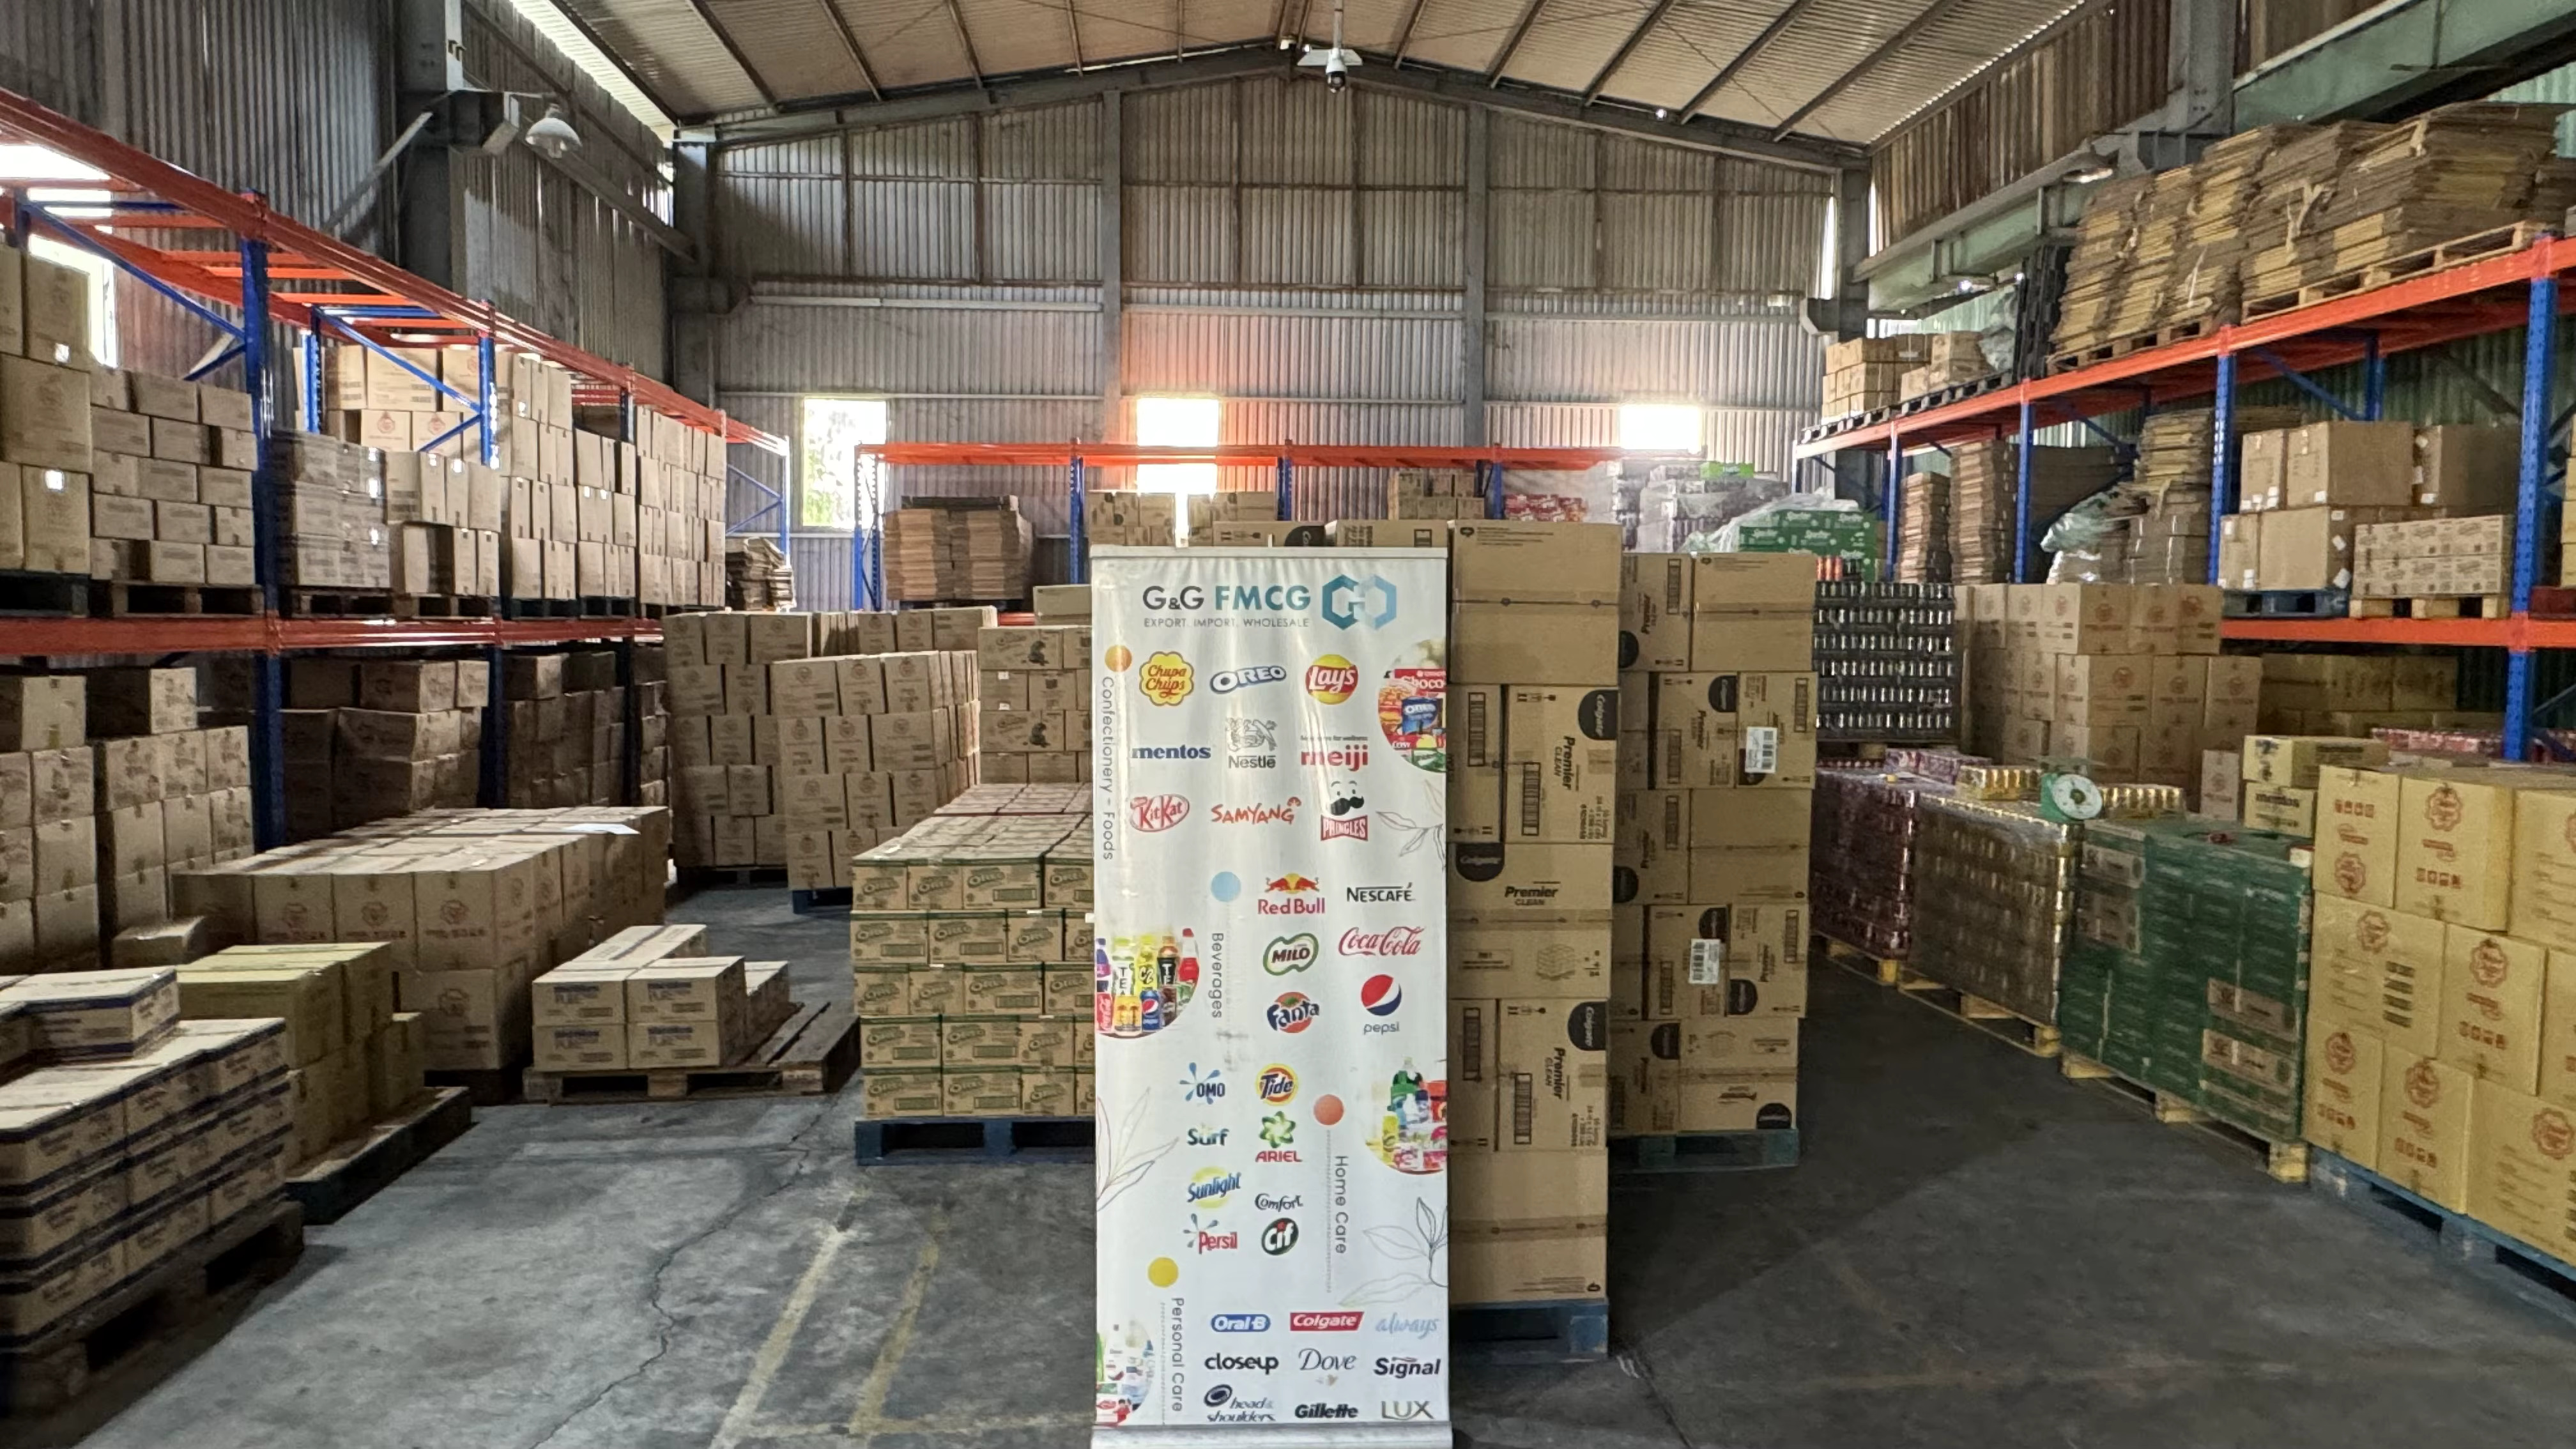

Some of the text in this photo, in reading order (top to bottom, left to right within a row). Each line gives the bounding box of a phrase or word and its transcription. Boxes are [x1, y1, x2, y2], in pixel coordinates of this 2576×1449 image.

[1142, 585, 1310, 611] G&G FMCG
[1243, 617, 1309, 627] WHOLESALE
[1147, 664, 1187, 678] Chupa
[1211, 666, 1286, 693] OREO
[1146, 676, 1185, 698] Chups
[1100, 676, 1116, 793] Confectionery
[1131, 744, 1211, 759] mentos
[1301, 744, 1368, 772] meiji
[1562, 735, 1576, 791] Premier
[1139, 795, 1184, 829] KitKat
[1210, 802, 1296, 825] SAMYANG
[1103, 811, 1116, 860] Foods
[1322, 816, 1367, 840] PRINGLES
[1346, 882, 1413, 902] NESCAFÉ
[1504, 885, 1559, 898] Premier
[1257, 897, 1325, 914] Red Bull
[1338, 926, 1426, 956] Coca-Cola
[1271, 947, 1310, 963] MILO
[1208, 933, 1224, 1018] Beverages
[1266, 1000, 1320, 1031] Fanta
[1363, 1022, 1400, 1036] pepsi
[1553, 1046, 1566, 1100] Premier
[1196, 1082, 1225, 1098] OMO
[1260, 1073, 1294, 1100] Tide
[1187, 1127, 1230, 1146] Surf
[1255, 1151, 1303, 1163] ARIEL
[1186, 1172, 1242, 1203] Sunlight
[1254, 1192, 1304, 1213] Comfort
[1334, 1155, 1349, 1254] Home Care
[1198, 1230, 1238, 1255] Persil
[1264, 1221, 1294, 1251] Cif
[1213, 1315, 1267, 1331] Oral-B
[1292, 1313, 1357, 1330] Colgate
[1375, 1312, 1439, 1340] always
[1170, 1297, 1184, 1412] Personal Care
[1204, 1352, 1279, 1375] closeup
[1298, 1347, 1357, 1372] Dove
[1373, 1357, 1441, 1379] Signal
[1294, 1403, 1359, 1419] Gillette
[1381, 1400, 1434, 1421] LUX
